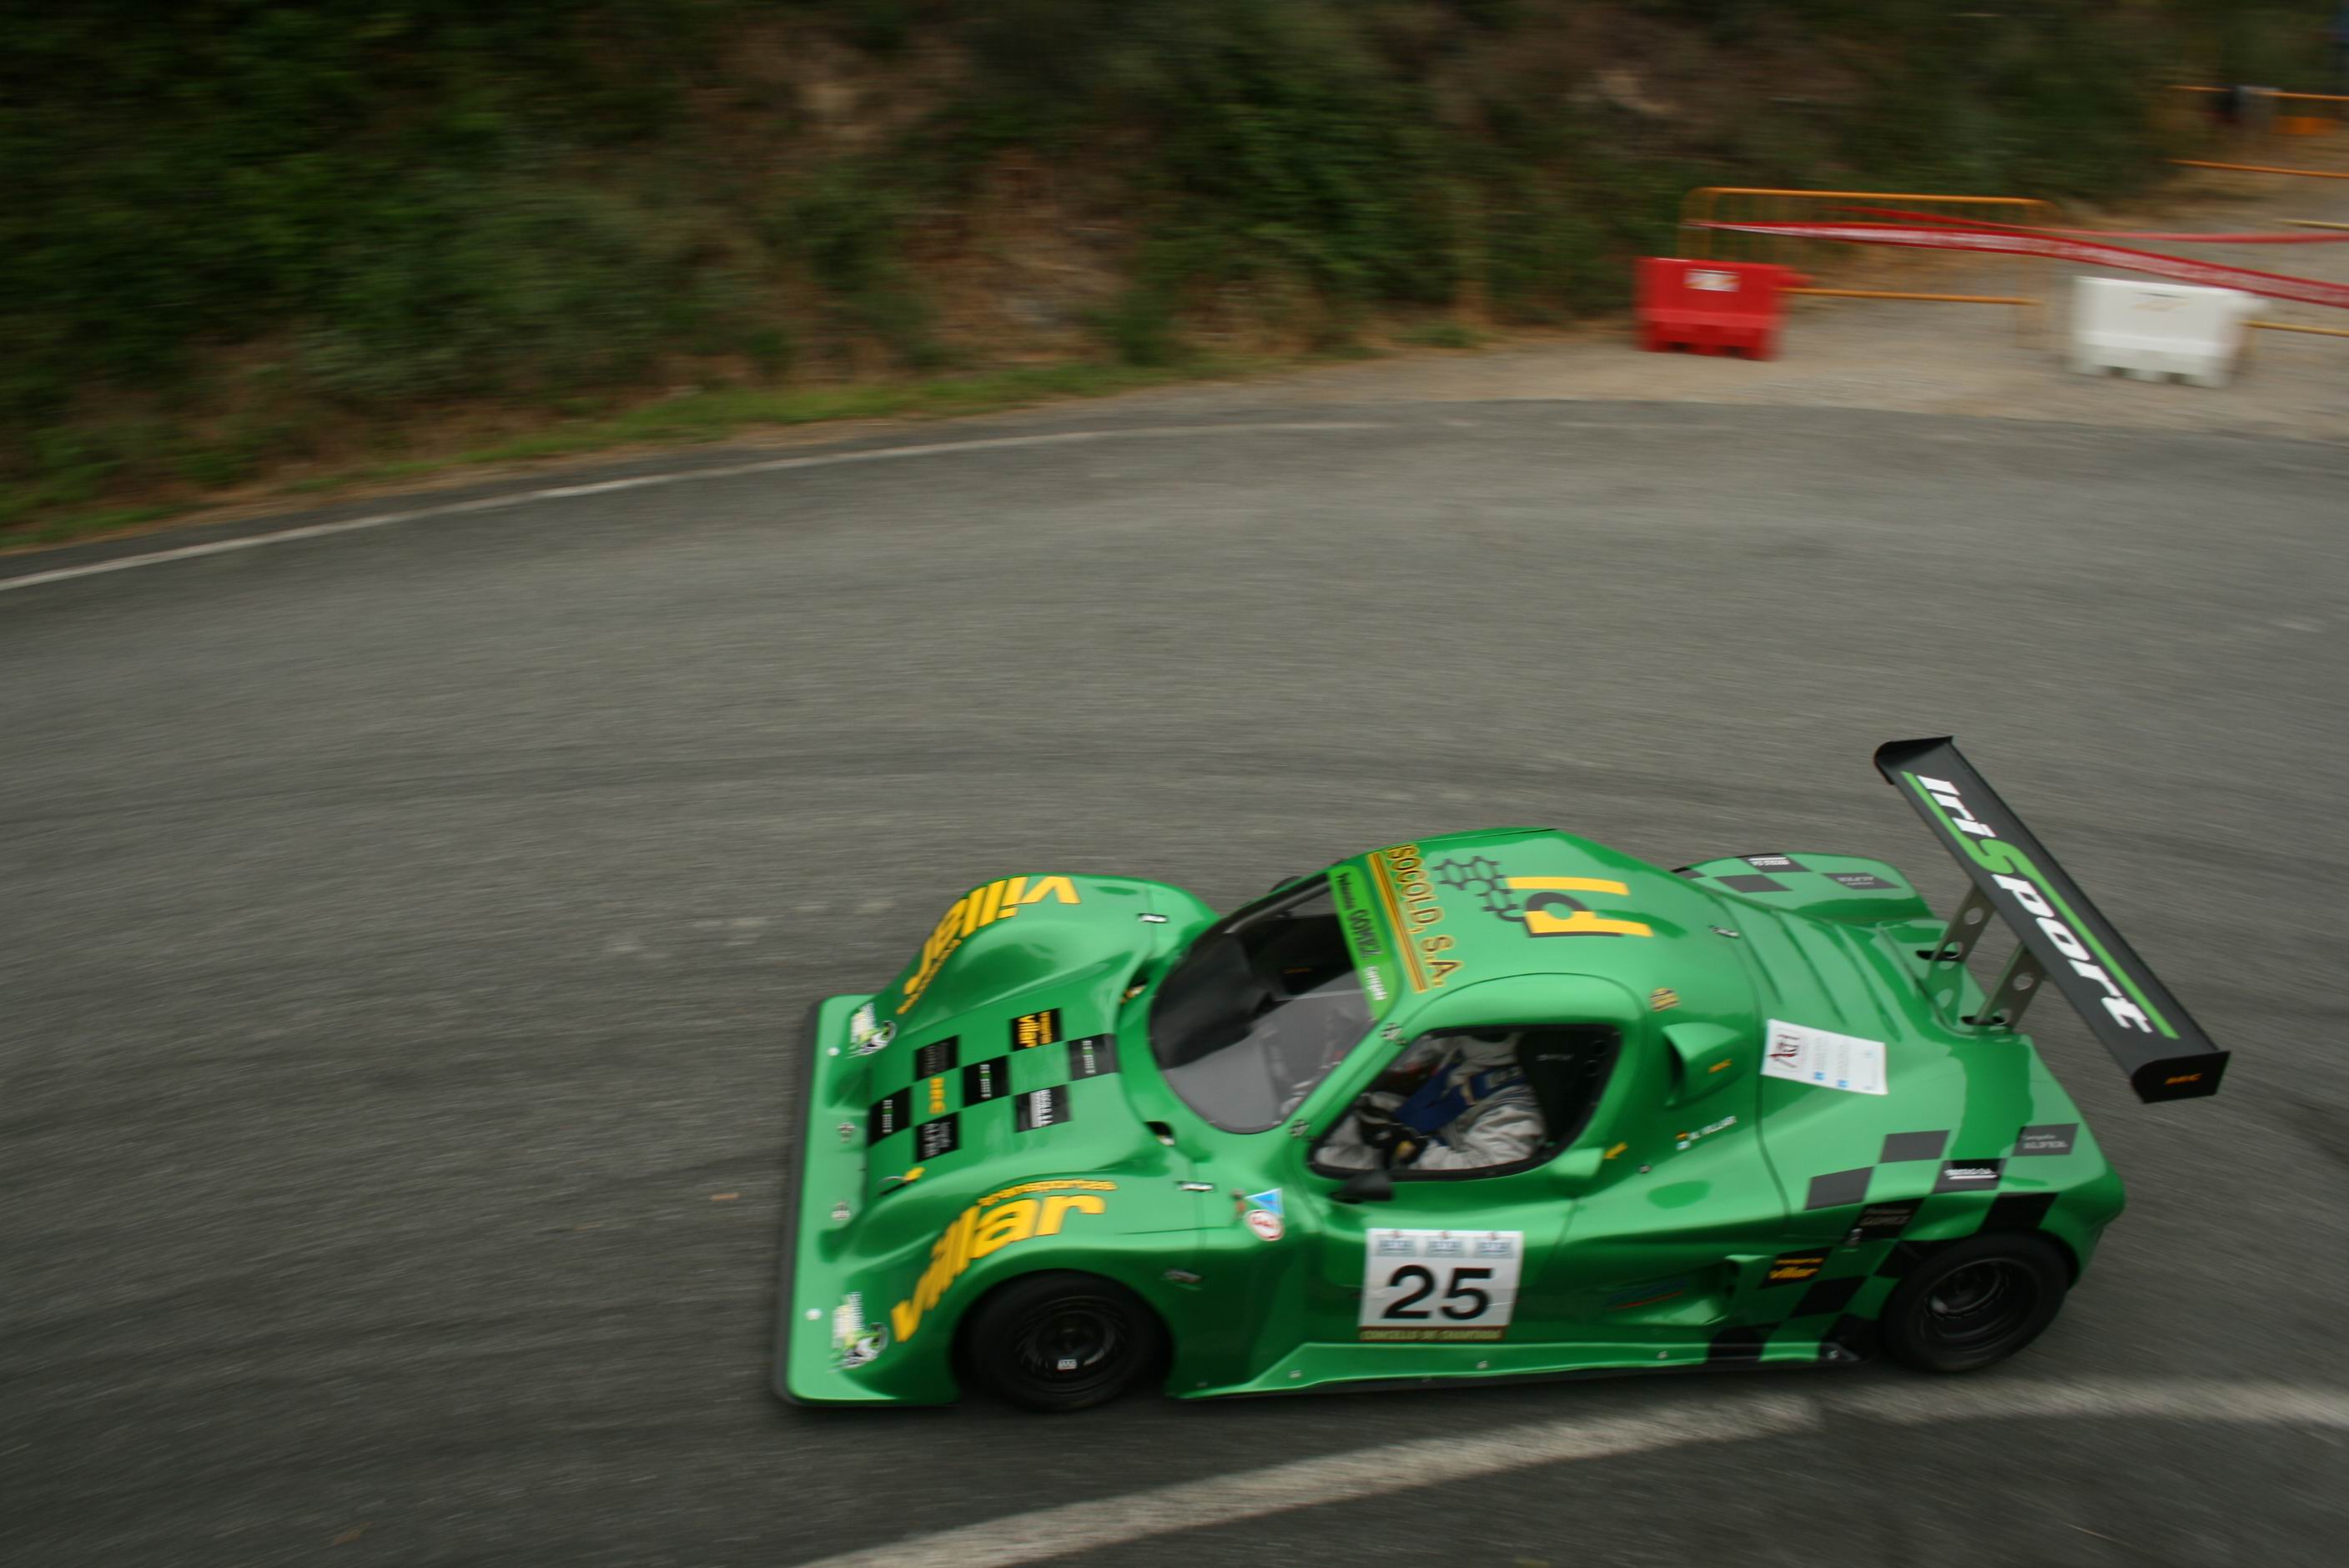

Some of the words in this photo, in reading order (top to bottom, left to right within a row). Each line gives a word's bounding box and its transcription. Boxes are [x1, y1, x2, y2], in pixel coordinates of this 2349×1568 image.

[1916, 775, 2152, 1034] IriSport
[892, 1194, 1105, 1342] villar
[1381, 1264, 1495, 1320] 25
